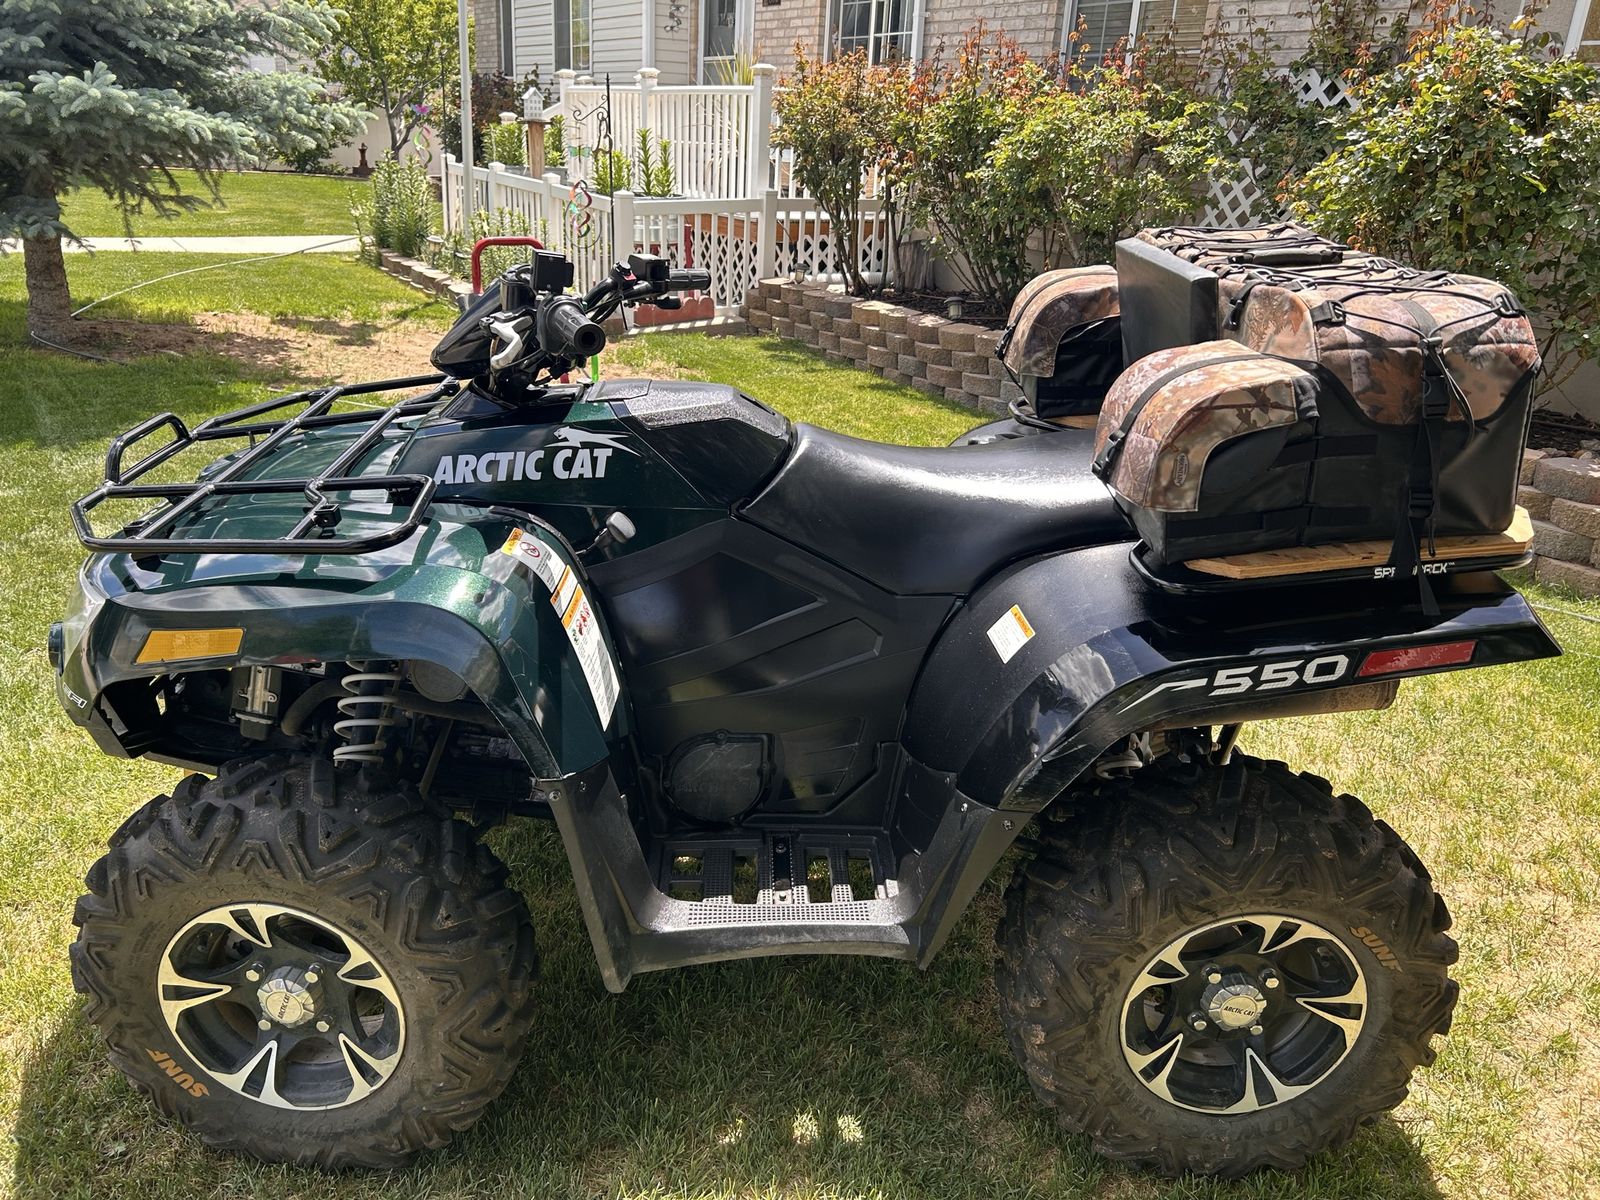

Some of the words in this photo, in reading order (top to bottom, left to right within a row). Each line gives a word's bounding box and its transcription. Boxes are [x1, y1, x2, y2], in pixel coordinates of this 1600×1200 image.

[434, 450, 545, 485] ARCTIC
[552, 448, 613, 480] CAT
[1208, 654, 1349, 697] 550
[1349, 926, 1403, 973] SUNF
[1223, 1006, 1244, 1015] ARCTIC
[145, 1048, 210, 1098] SUNF
